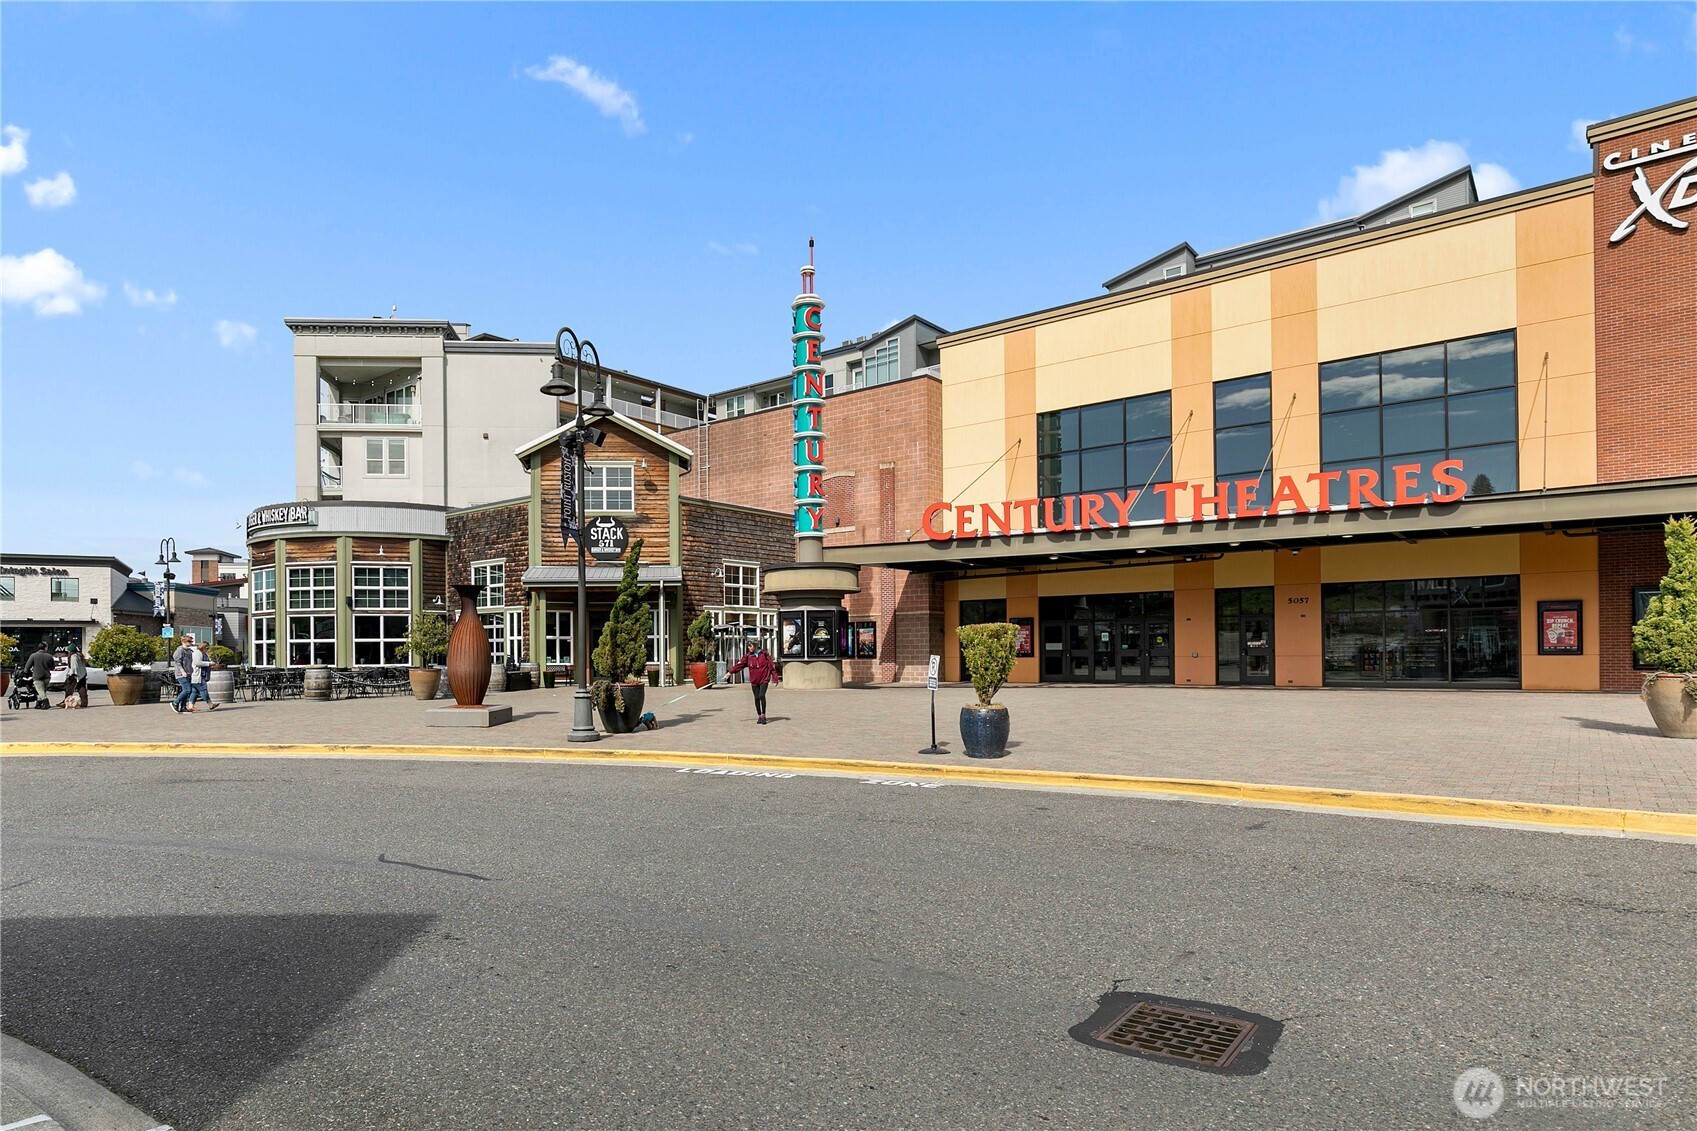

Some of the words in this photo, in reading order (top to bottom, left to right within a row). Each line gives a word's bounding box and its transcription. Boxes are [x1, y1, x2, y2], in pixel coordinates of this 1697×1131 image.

[802, 306, 827, 530] CENTURY
[563, 456, 572, 491] RUSTON
[563, 492, 572, 519] POINT
[922, 489, 1140, 541] CENTURY
[1152, 459, 1468, 524] THEATRES
[262, 507, 288, 523] WHISKEY
[290, 505, 308, 520] BAR
[590, 527, 624, 540] STACK
[598, 539, 614, 547] 571
[40, 566, 69, 576] Salon
[1287, 597, 1309, 605] 5057
[676, 767, 797, 779] LOADING
